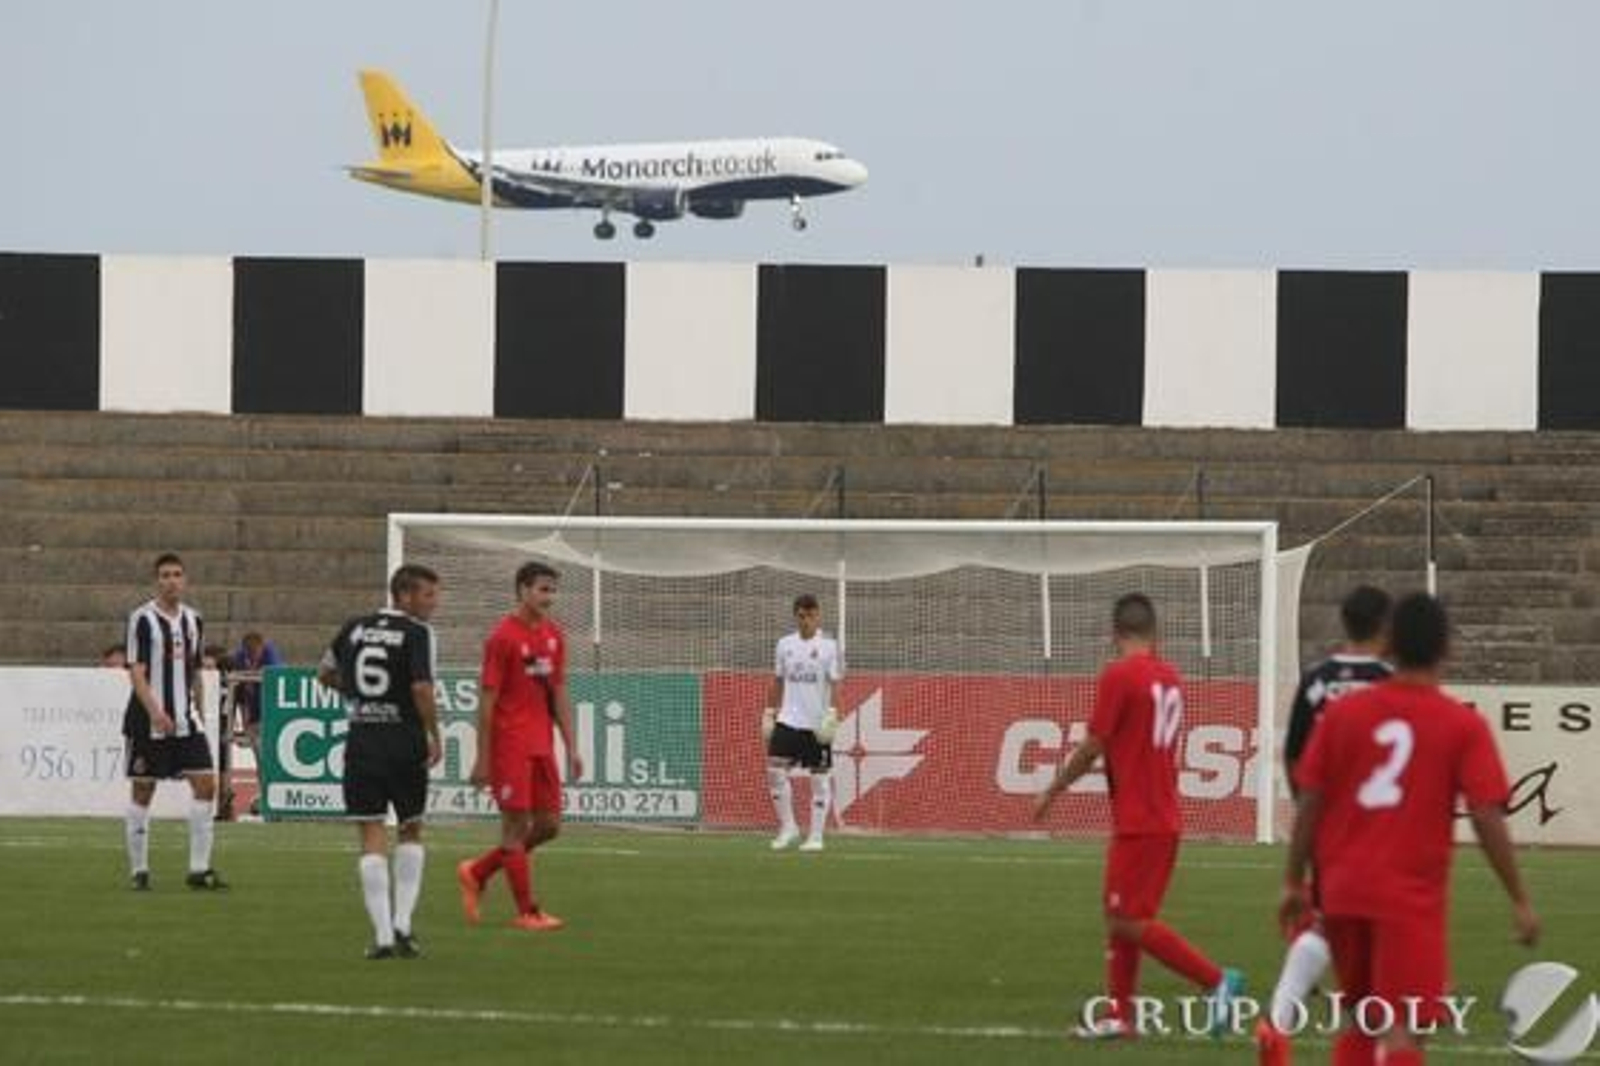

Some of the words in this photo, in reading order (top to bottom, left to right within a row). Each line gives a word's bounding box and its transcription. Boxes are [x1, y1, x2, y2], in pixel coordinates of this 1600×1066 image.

[277, 676, 479, 712] LIMAS
[355, 645, 390, 698] 6
[1151, 682, 1184, 748] 10
[20, 744, 75, 781] 956
[1357, 718, 1415, 811] 2
[579, 792, 625, 811] 030
[635, 793, 680, 812] 271
